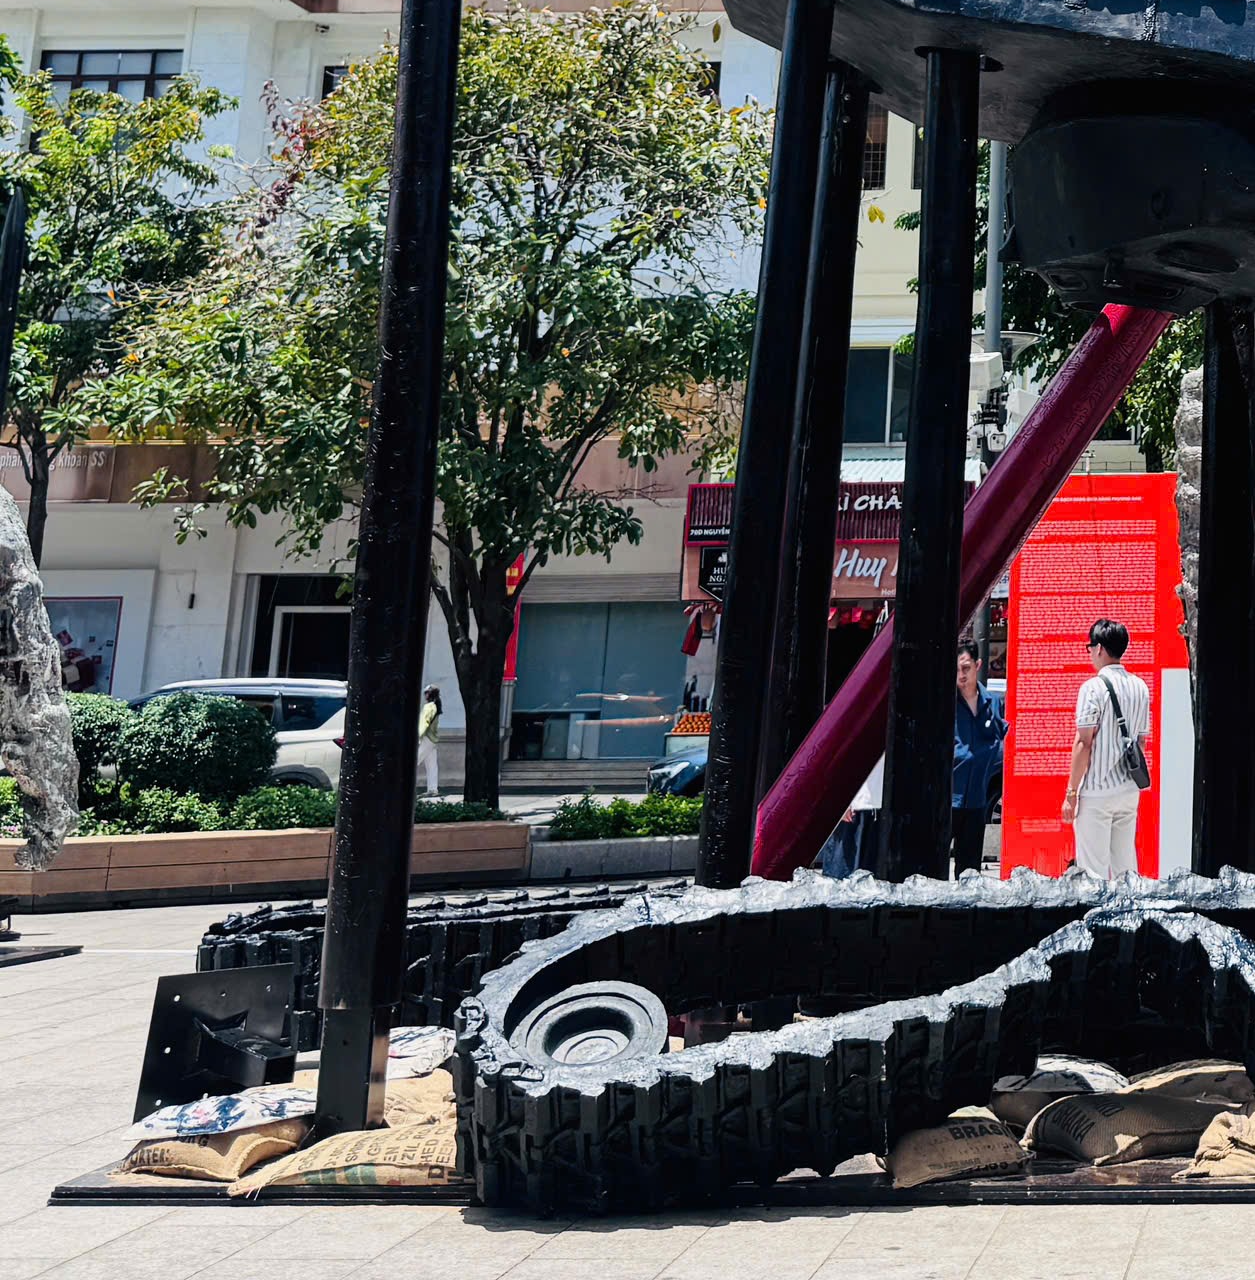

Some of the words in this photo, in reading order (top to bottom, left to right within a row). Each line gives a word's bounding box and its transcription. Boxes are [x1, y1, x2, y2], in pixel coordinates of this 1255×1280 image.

[854, 487, 902, 511] CHẢ
[713, 567, 727, 575] HU
[834, 548, 887, 588] Huy
